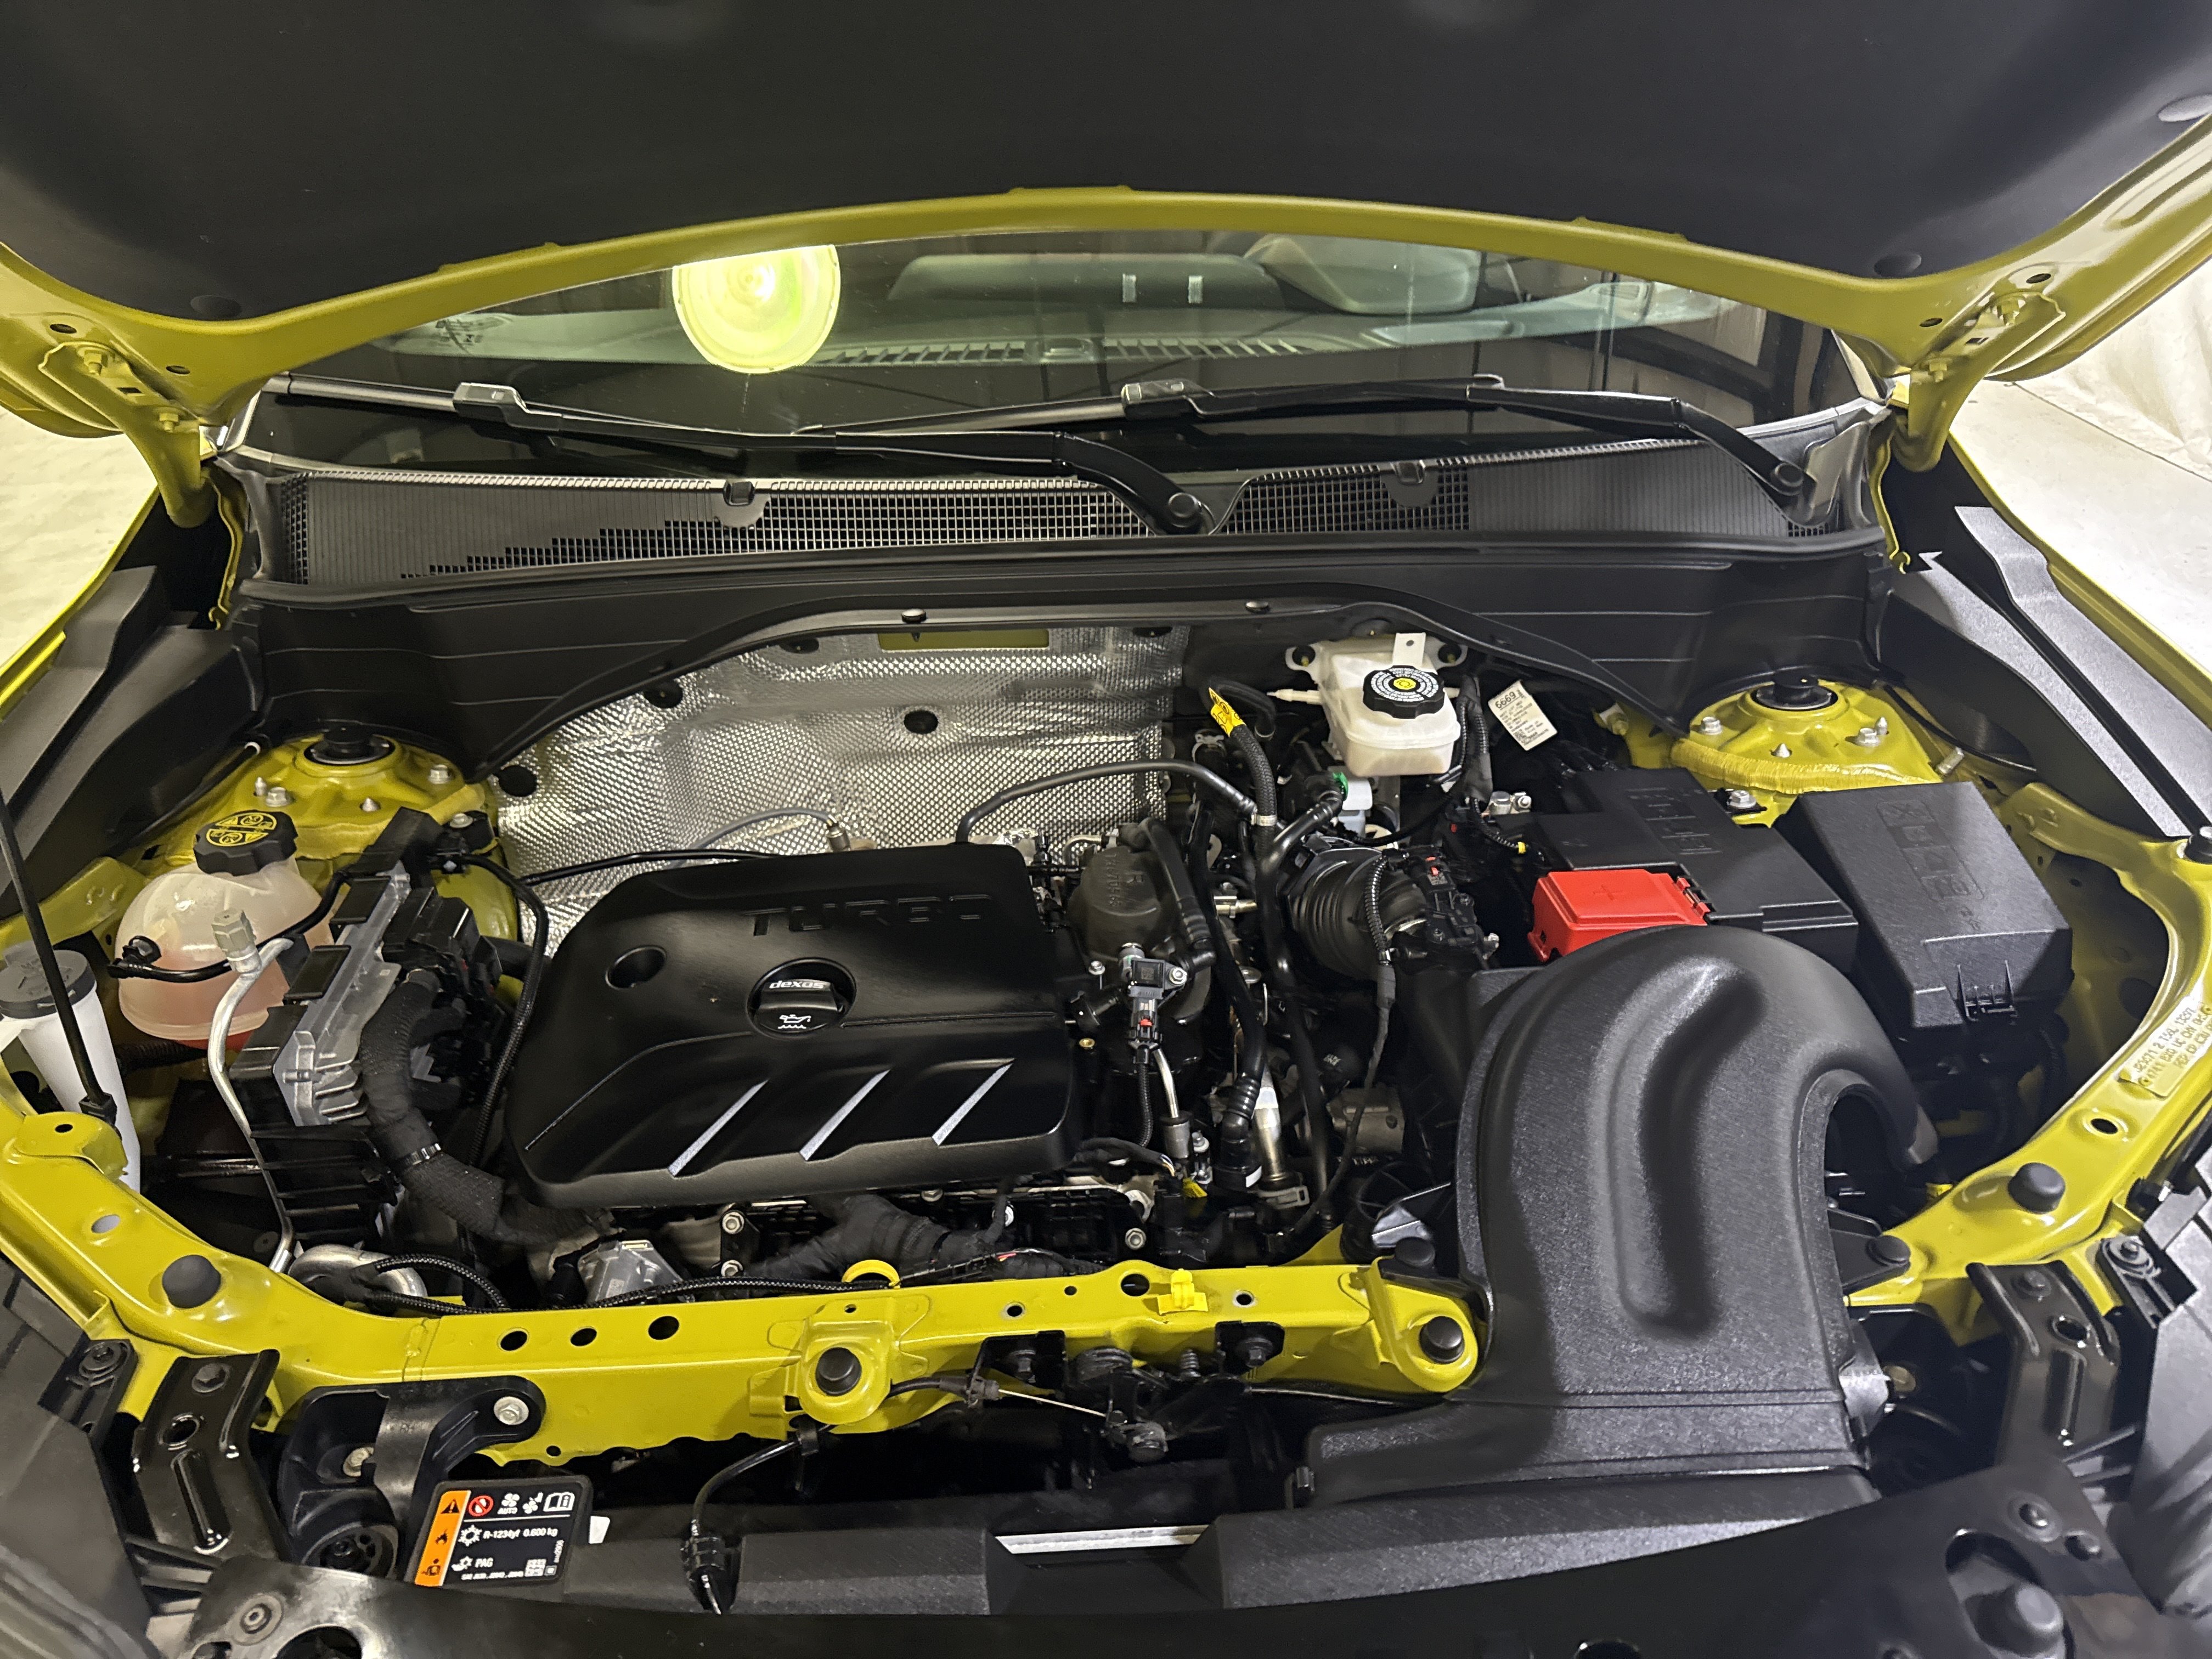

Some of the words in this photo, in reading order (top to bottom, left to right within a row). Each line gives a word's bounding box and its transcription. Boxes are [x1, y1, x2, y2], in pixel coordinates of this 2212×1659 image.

[1495, 691, 1516, 709] 6669
[742, 894, 992, 936] TURBO
[769, 980, 826, 990] dexos
[547, 1527, 558, 1537] kg
[475, 1557, 494, 1568] PAG
